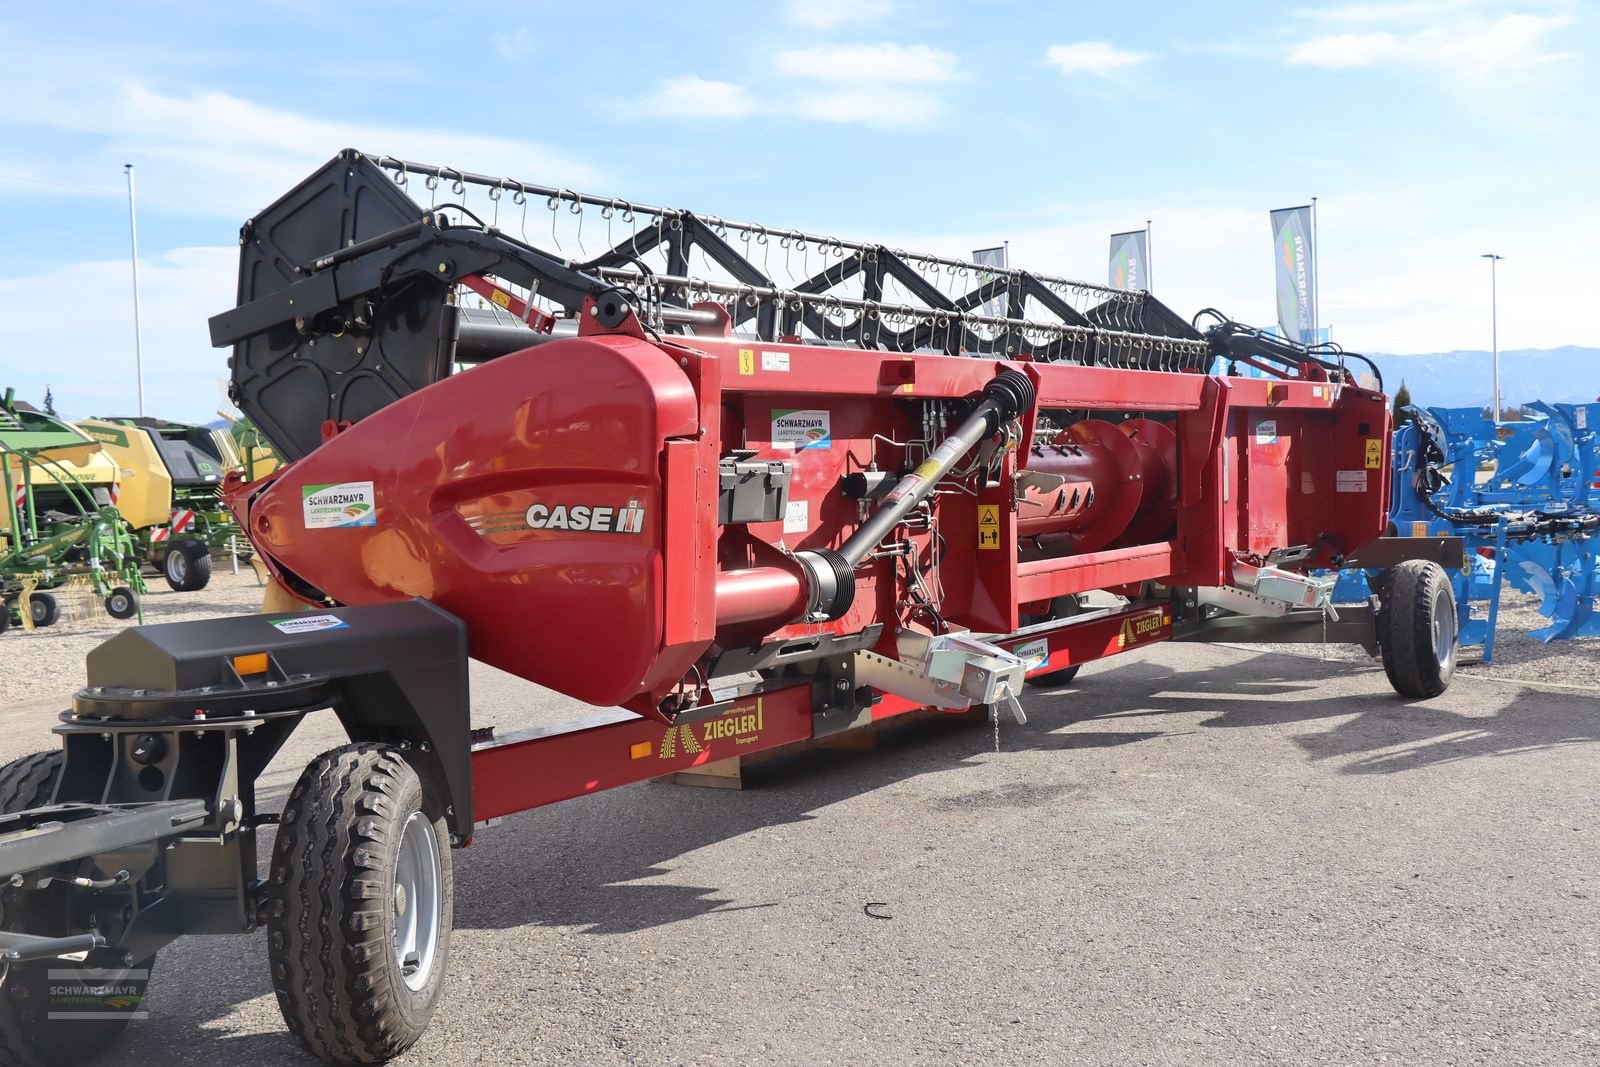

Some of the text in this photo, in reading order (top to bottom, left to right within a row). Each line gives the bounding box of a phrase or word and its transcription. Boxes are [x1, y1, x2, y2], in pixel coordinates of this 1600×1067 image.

[776, 419, 823, 428] SCHWARZMAYR
[309, 493, 364, 506] SCHWARZMAYR
[525, 503, 614, 532] CASE
[1136, 615, 1160, 635] ZIEGLER
[704, 715, 756, 740] ZIEGLER
